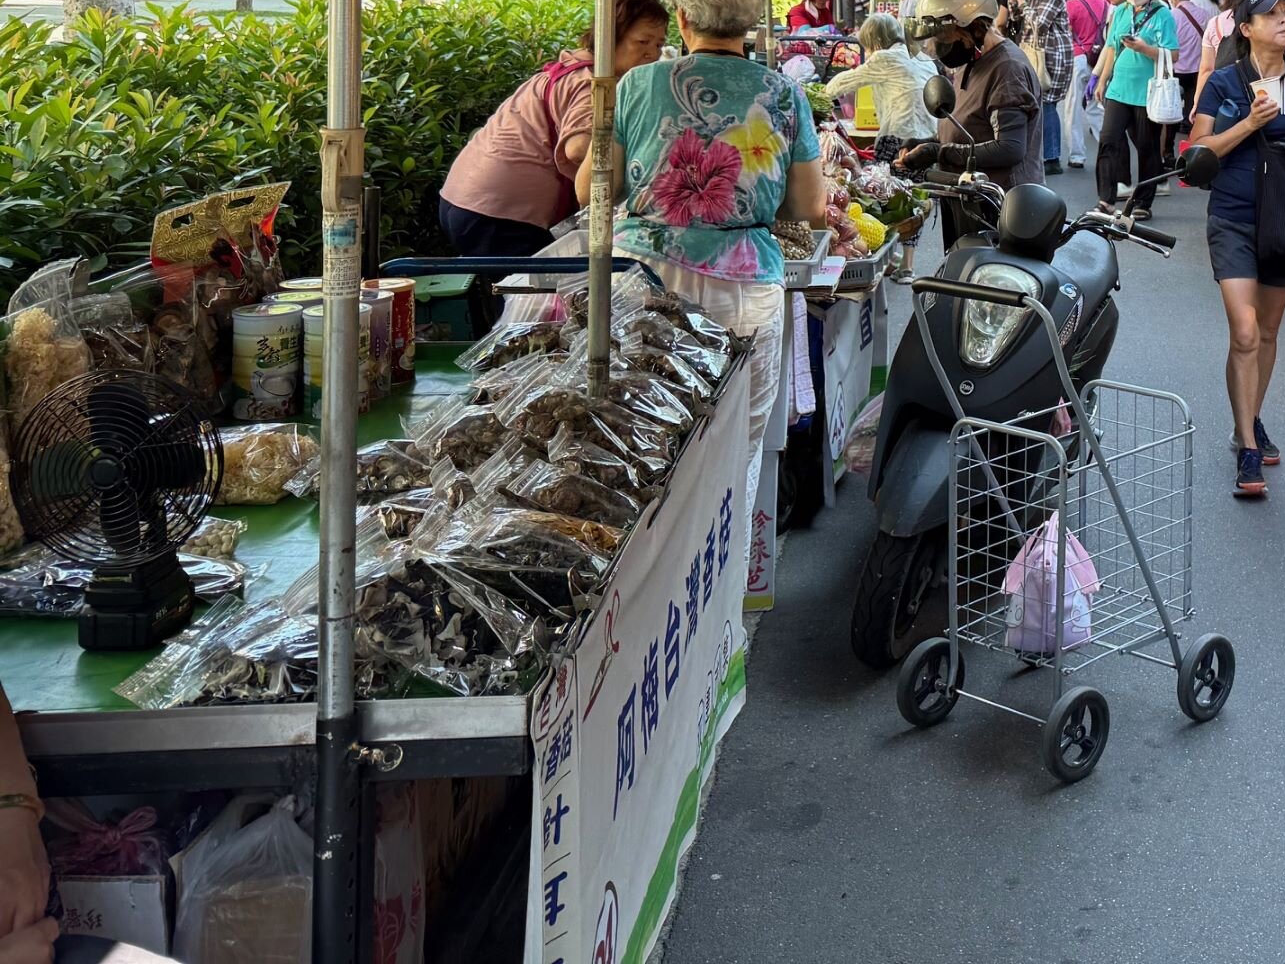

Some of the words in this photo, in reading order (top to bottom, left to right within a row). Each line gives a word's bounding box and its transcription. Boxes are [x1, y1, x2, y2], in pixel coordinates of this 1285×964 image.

[613, 486, 733, 823] 阿梅台灣香菇
